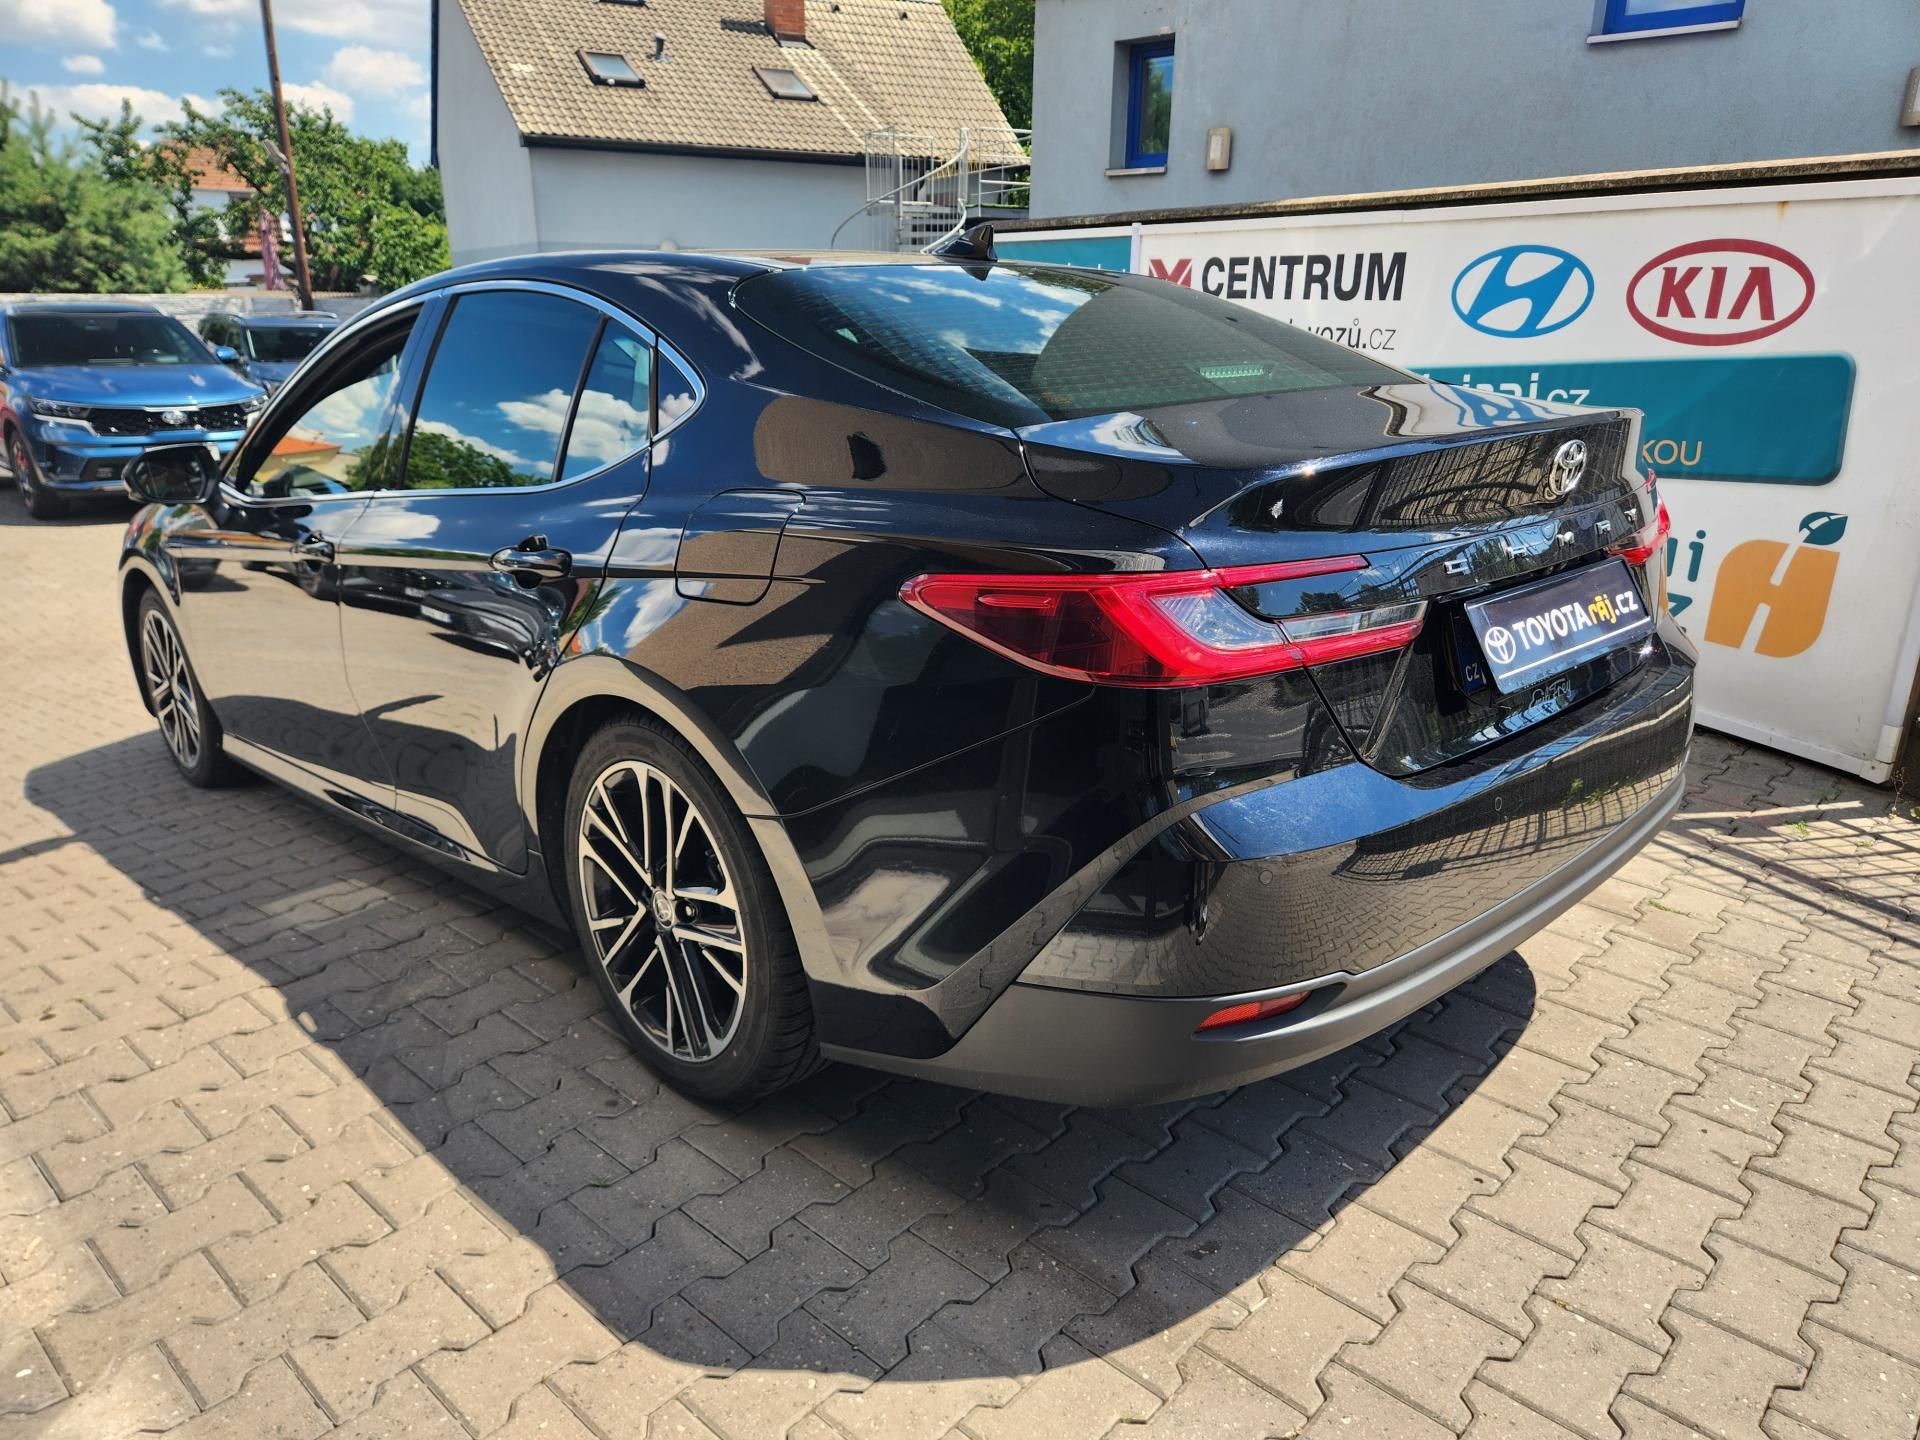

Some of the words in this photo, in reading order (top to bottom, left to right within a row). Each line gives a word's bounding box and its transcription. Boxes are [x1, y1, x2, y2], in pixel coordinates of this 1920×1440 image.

[1202, 252, 1407, 301] CENTRUM
[1656, 266, 1775, 320] KIA
[1465, 662, 1480, 682] CZ
